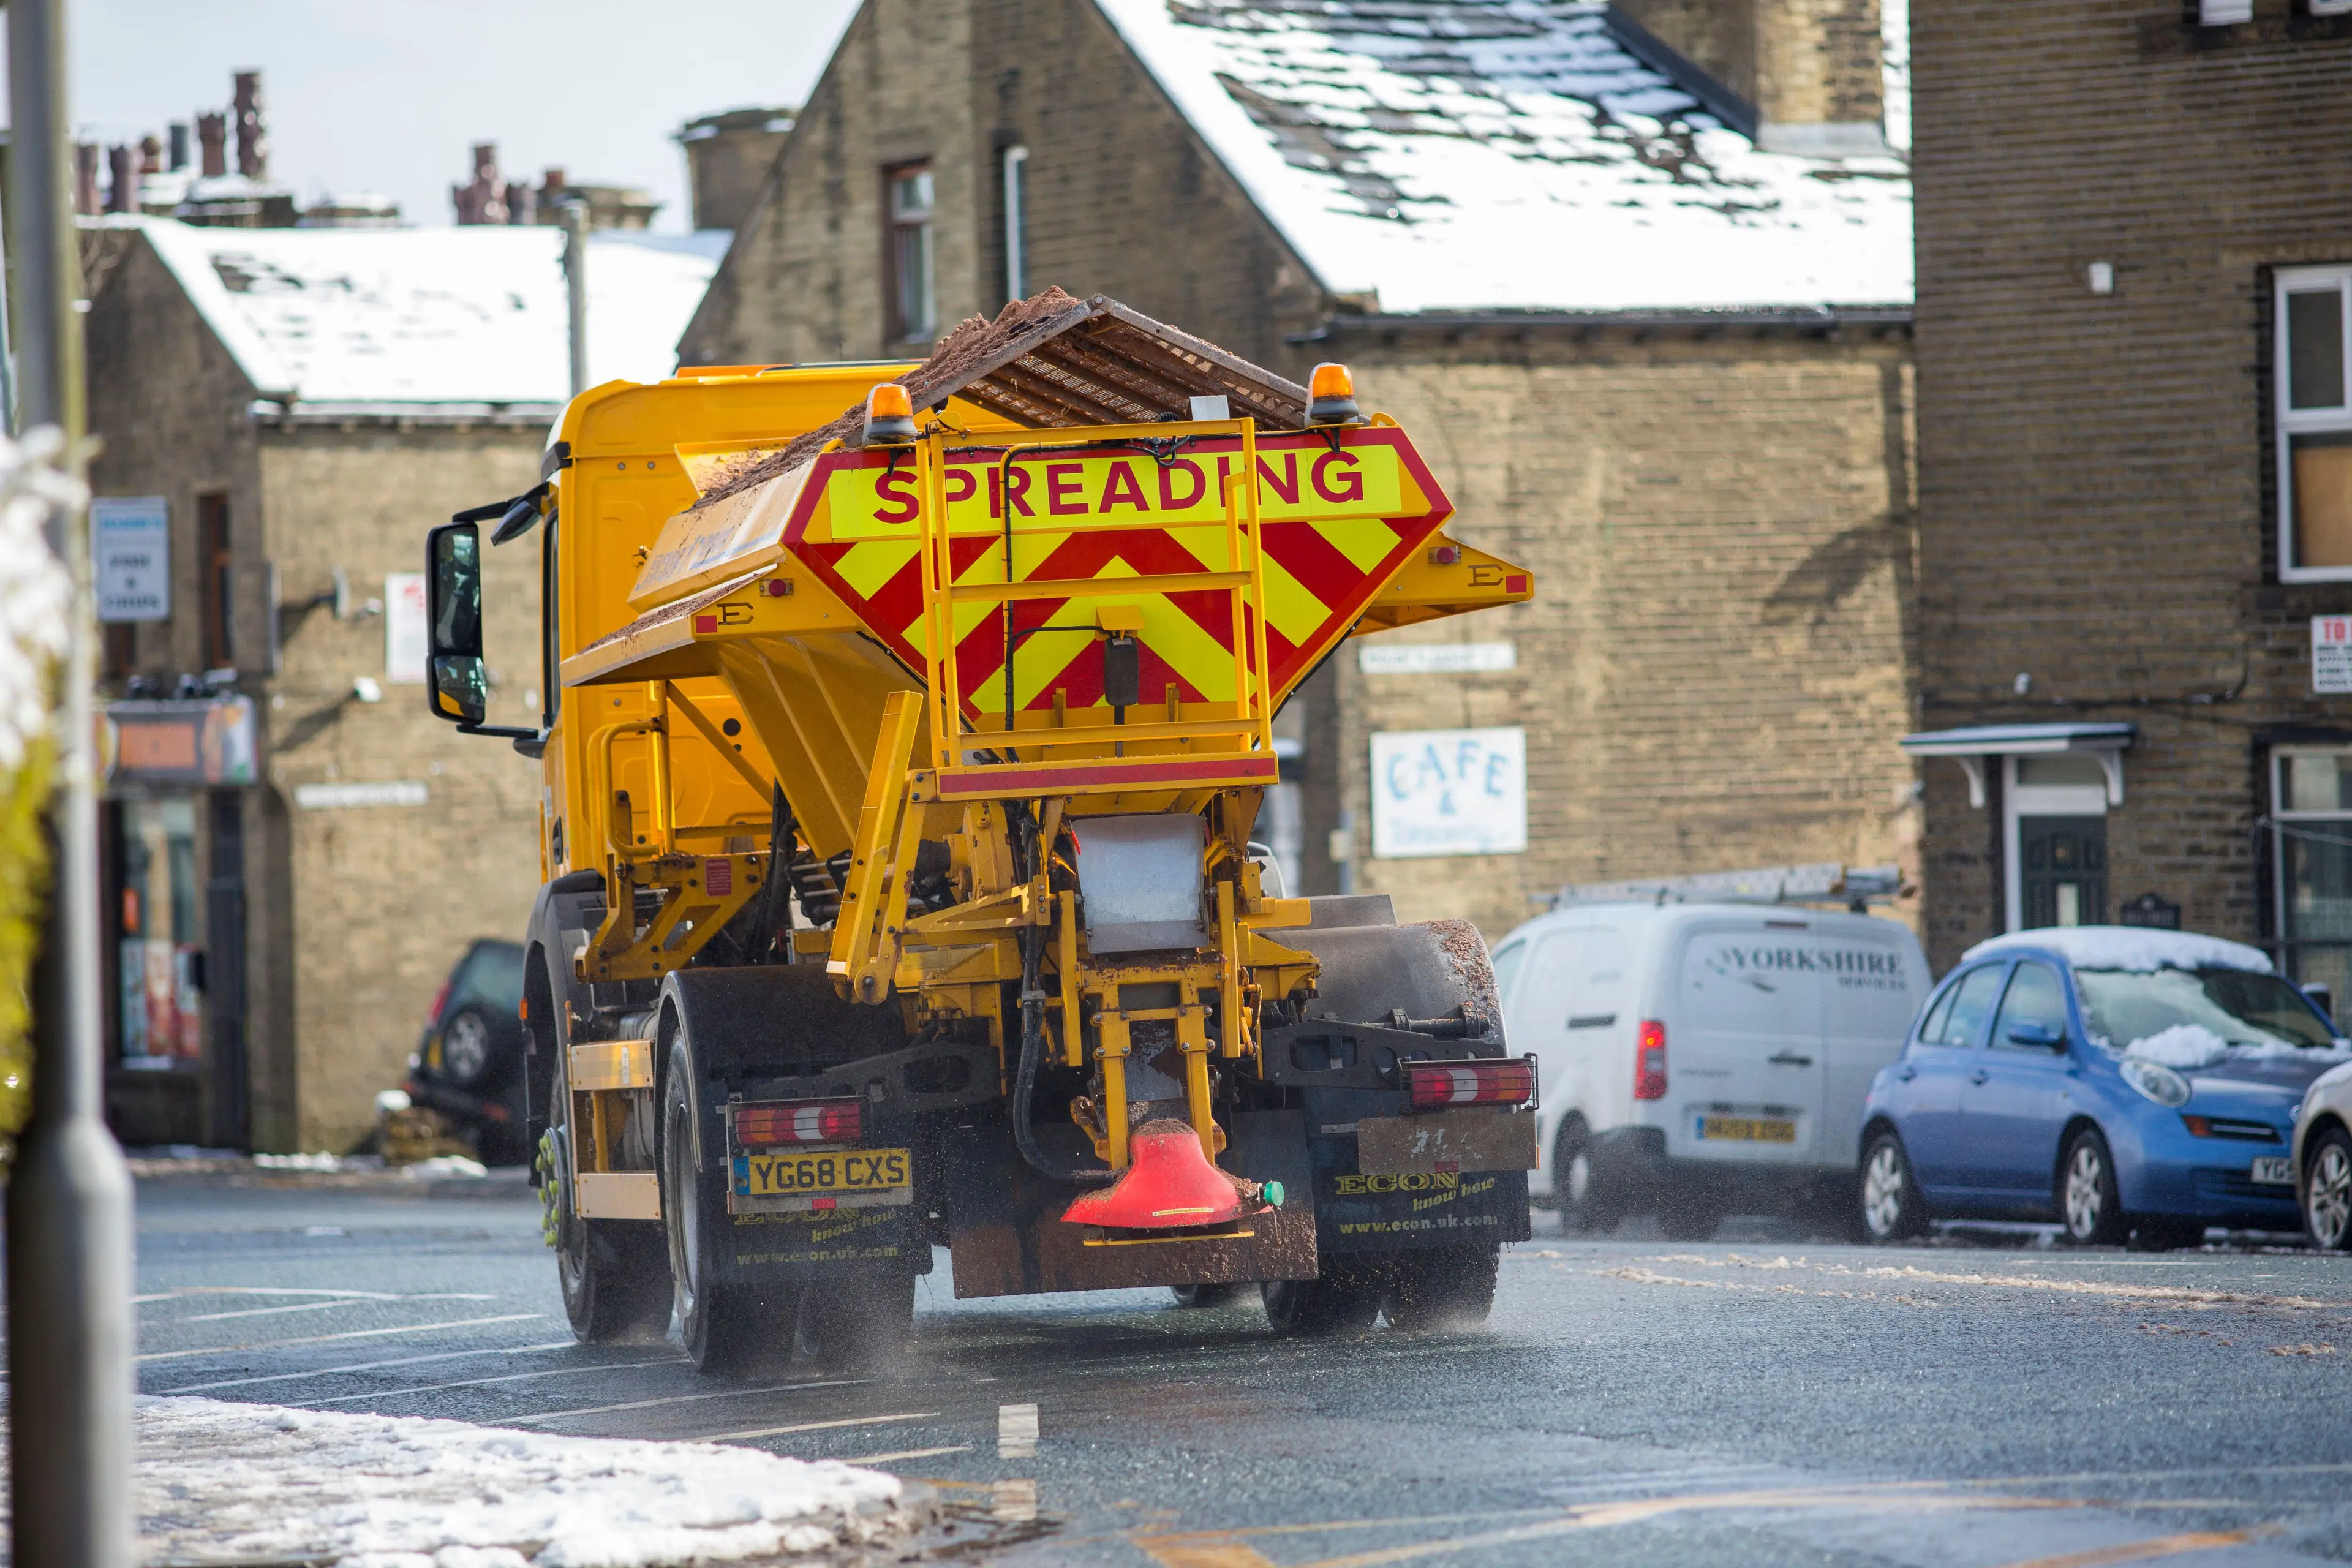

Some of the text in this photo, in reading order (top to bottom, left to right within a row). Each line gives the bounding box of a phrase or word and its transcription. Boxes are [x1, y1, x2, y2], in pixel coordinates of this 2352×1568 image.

[872, 450, 1365, 524] SPREADING
[1387, 739, 1509, 802] CAFE
[1728, 946, 1906, 975] YORKSHIRE
[755, 1155, 905, 1190] YG68 CXS
[1335, 1170, 1462, 1195] ECON
[1412, 1177, 1495, 1212] know how
[1338, 1214, 1498, 1234] www.econ.uk.com
